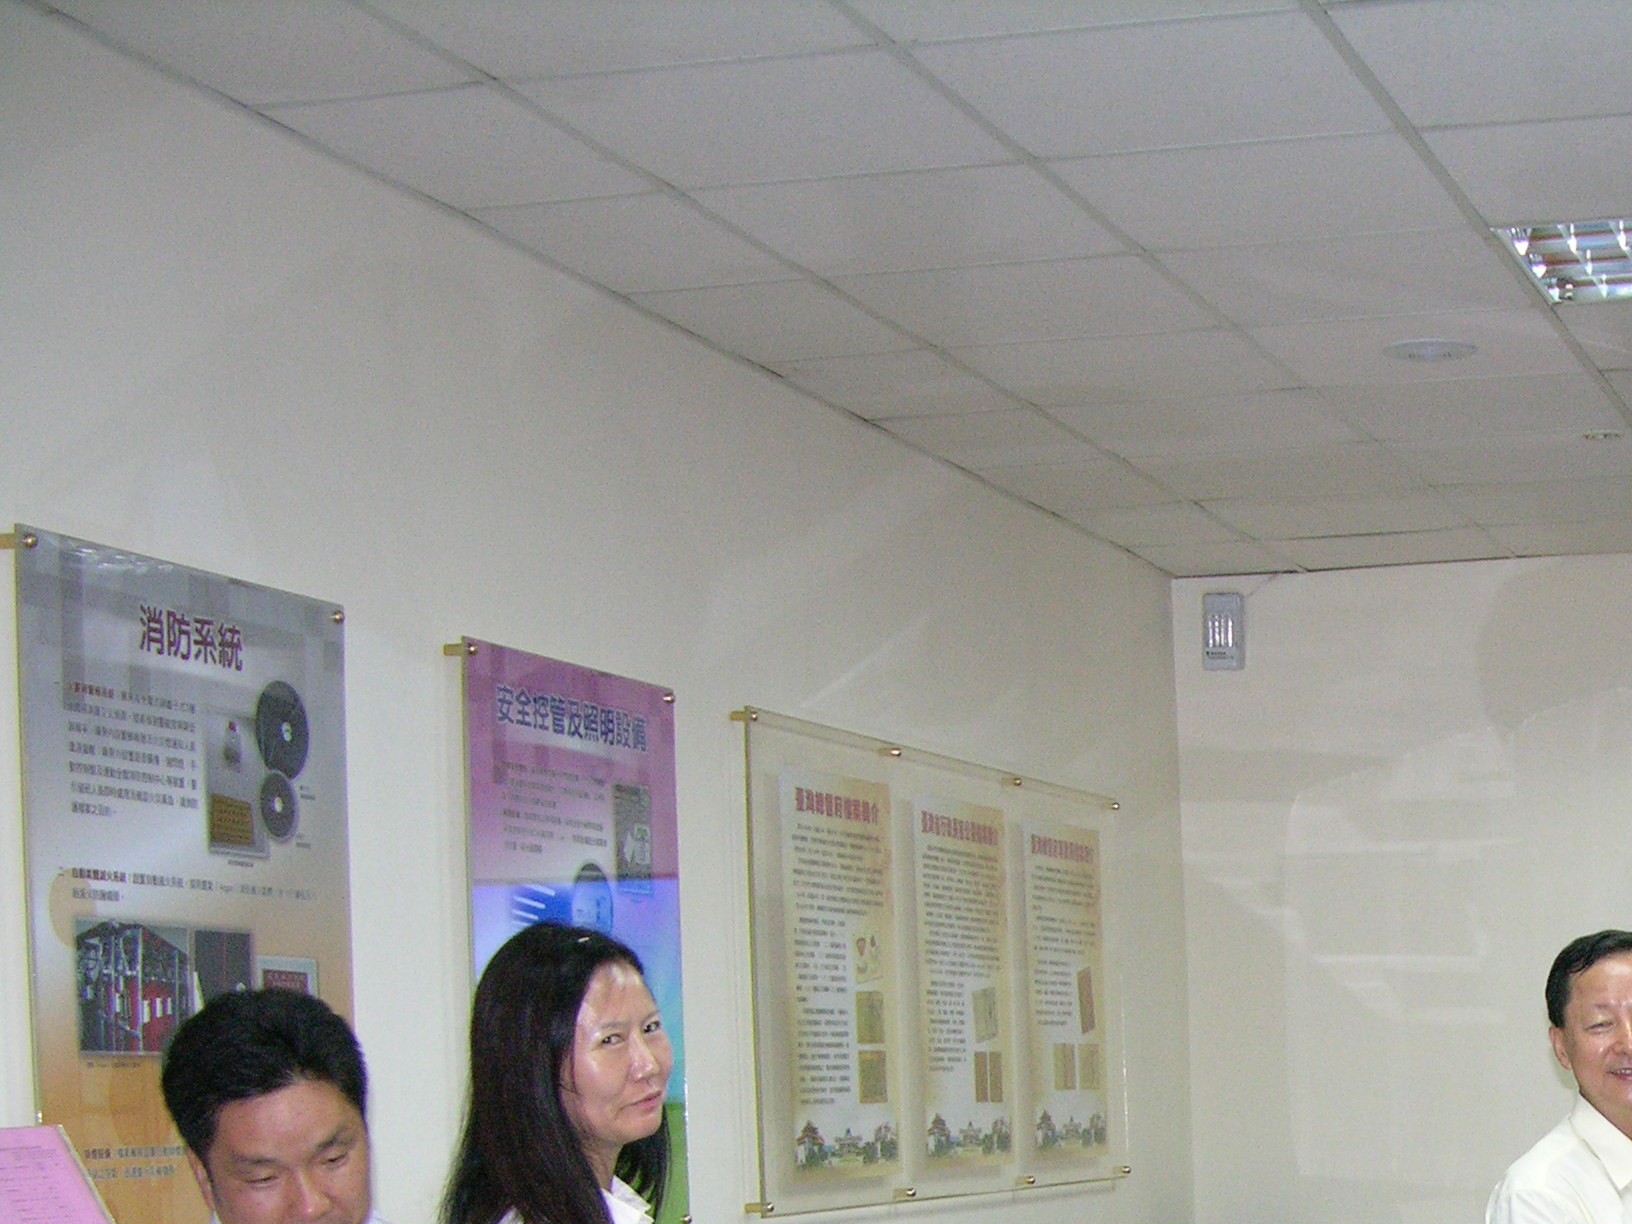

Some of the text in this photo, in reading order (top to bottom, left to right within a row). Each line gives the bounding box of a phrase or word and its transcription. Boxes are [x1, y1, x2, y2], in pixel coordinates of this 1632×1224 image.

[140, 604, 243, 671] 消防系統
[496, 684, 647, 752] 安全控管及照明設備
